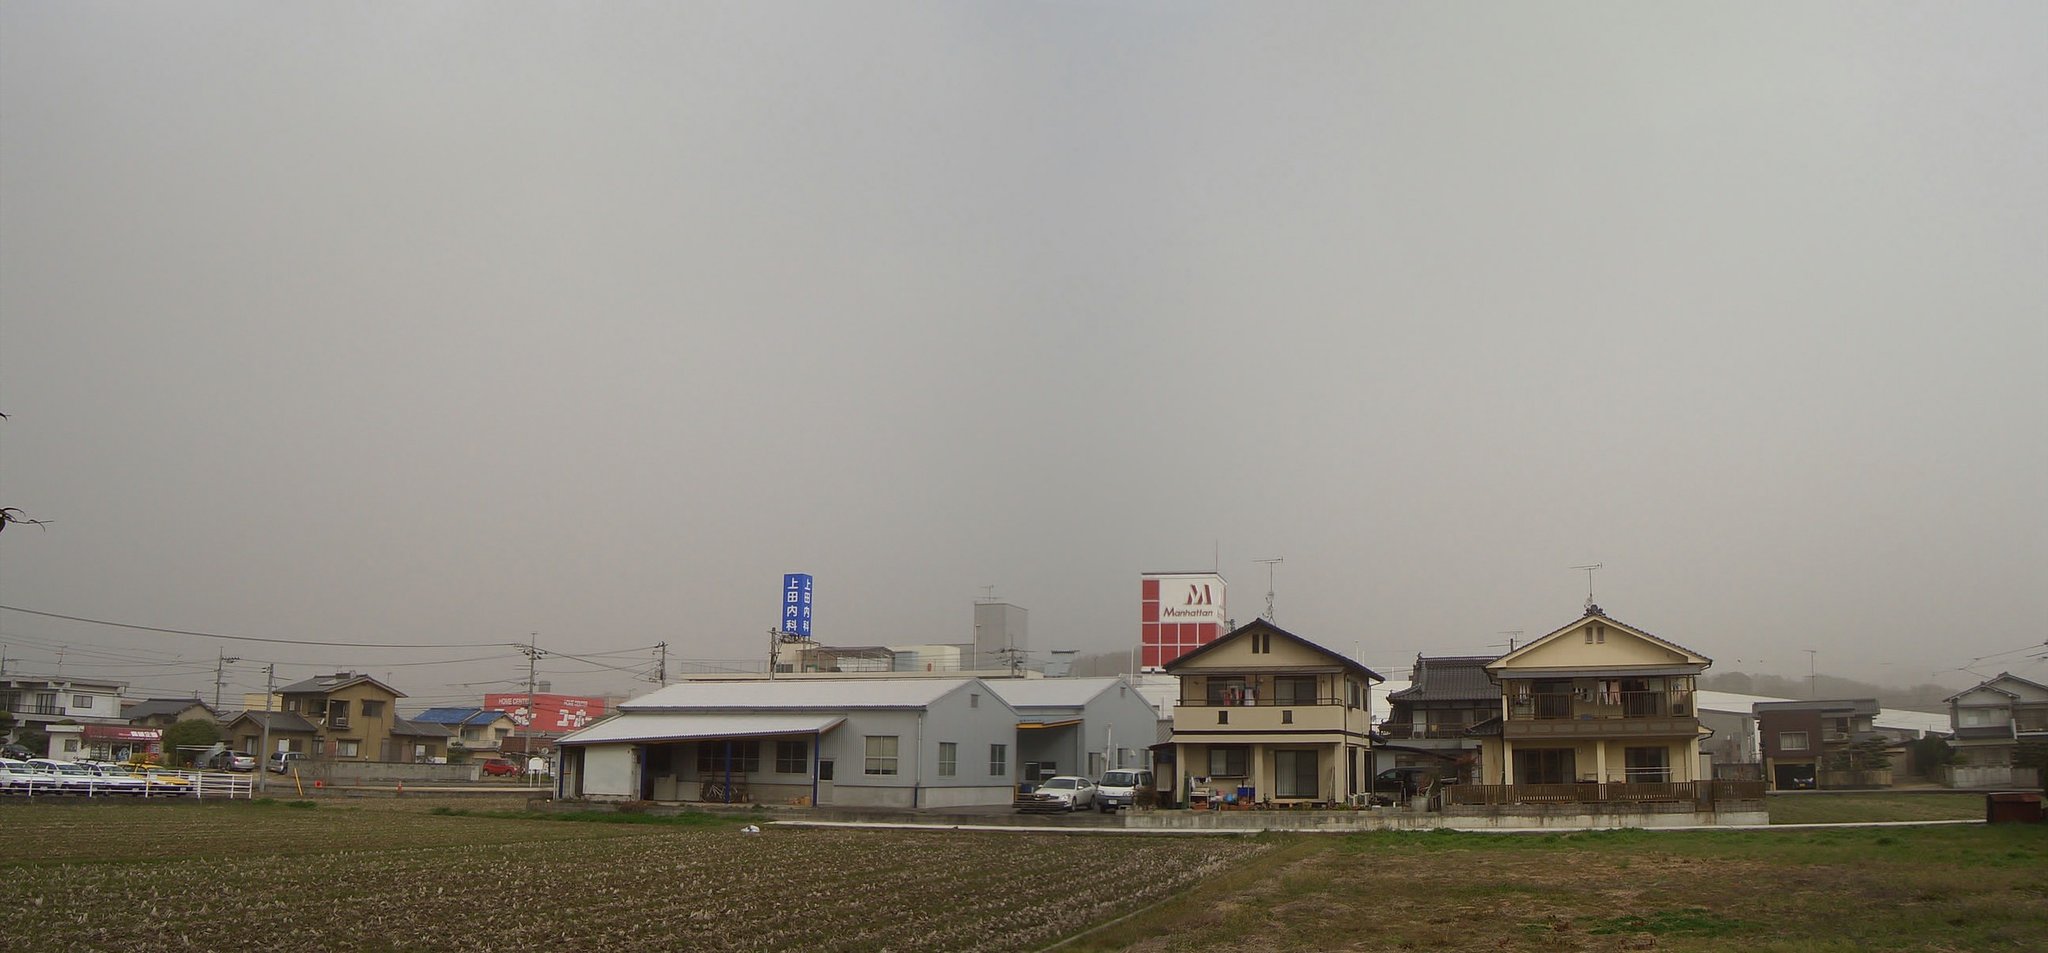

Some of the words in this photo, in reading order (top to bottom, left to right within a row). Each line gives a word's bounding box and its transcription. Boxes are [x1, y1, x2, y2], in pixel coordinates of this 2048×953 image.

[786, 577, 799, 631] 上田内科
[803, 578, 811, 632] 上田内科
[1163, 607, 1213, 617] Manhattan
[1185, 583, 1212, 605] M
